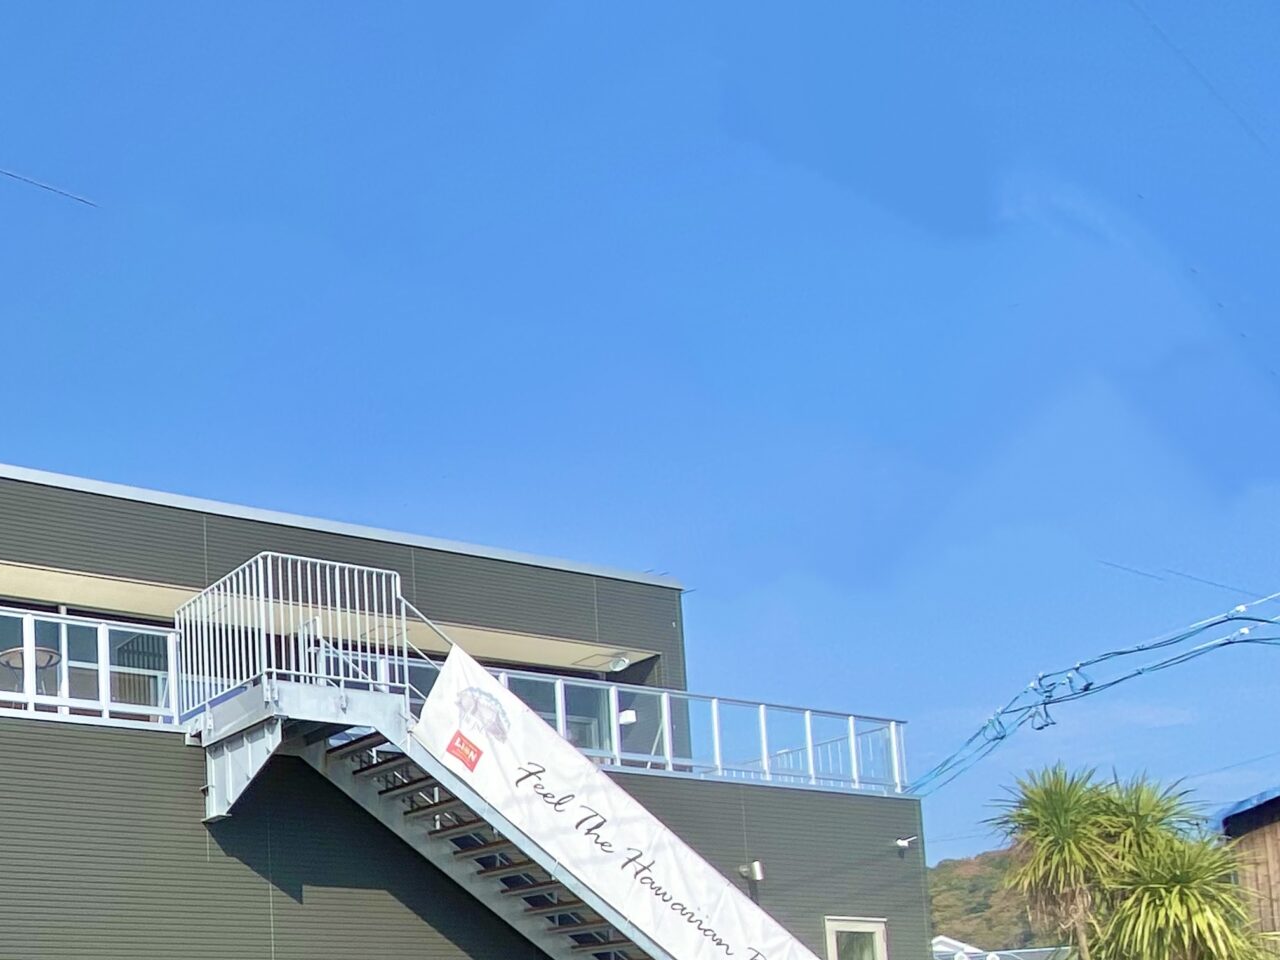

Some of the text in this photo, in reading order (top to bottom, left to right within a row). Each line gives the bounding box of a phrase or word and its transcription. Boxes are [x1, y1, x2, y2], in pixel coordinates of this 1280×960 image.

[515, 762, 575, 812] Feel
[575, 805, 614, 854] The
[621, 847, 734, 955] Hawaiian
